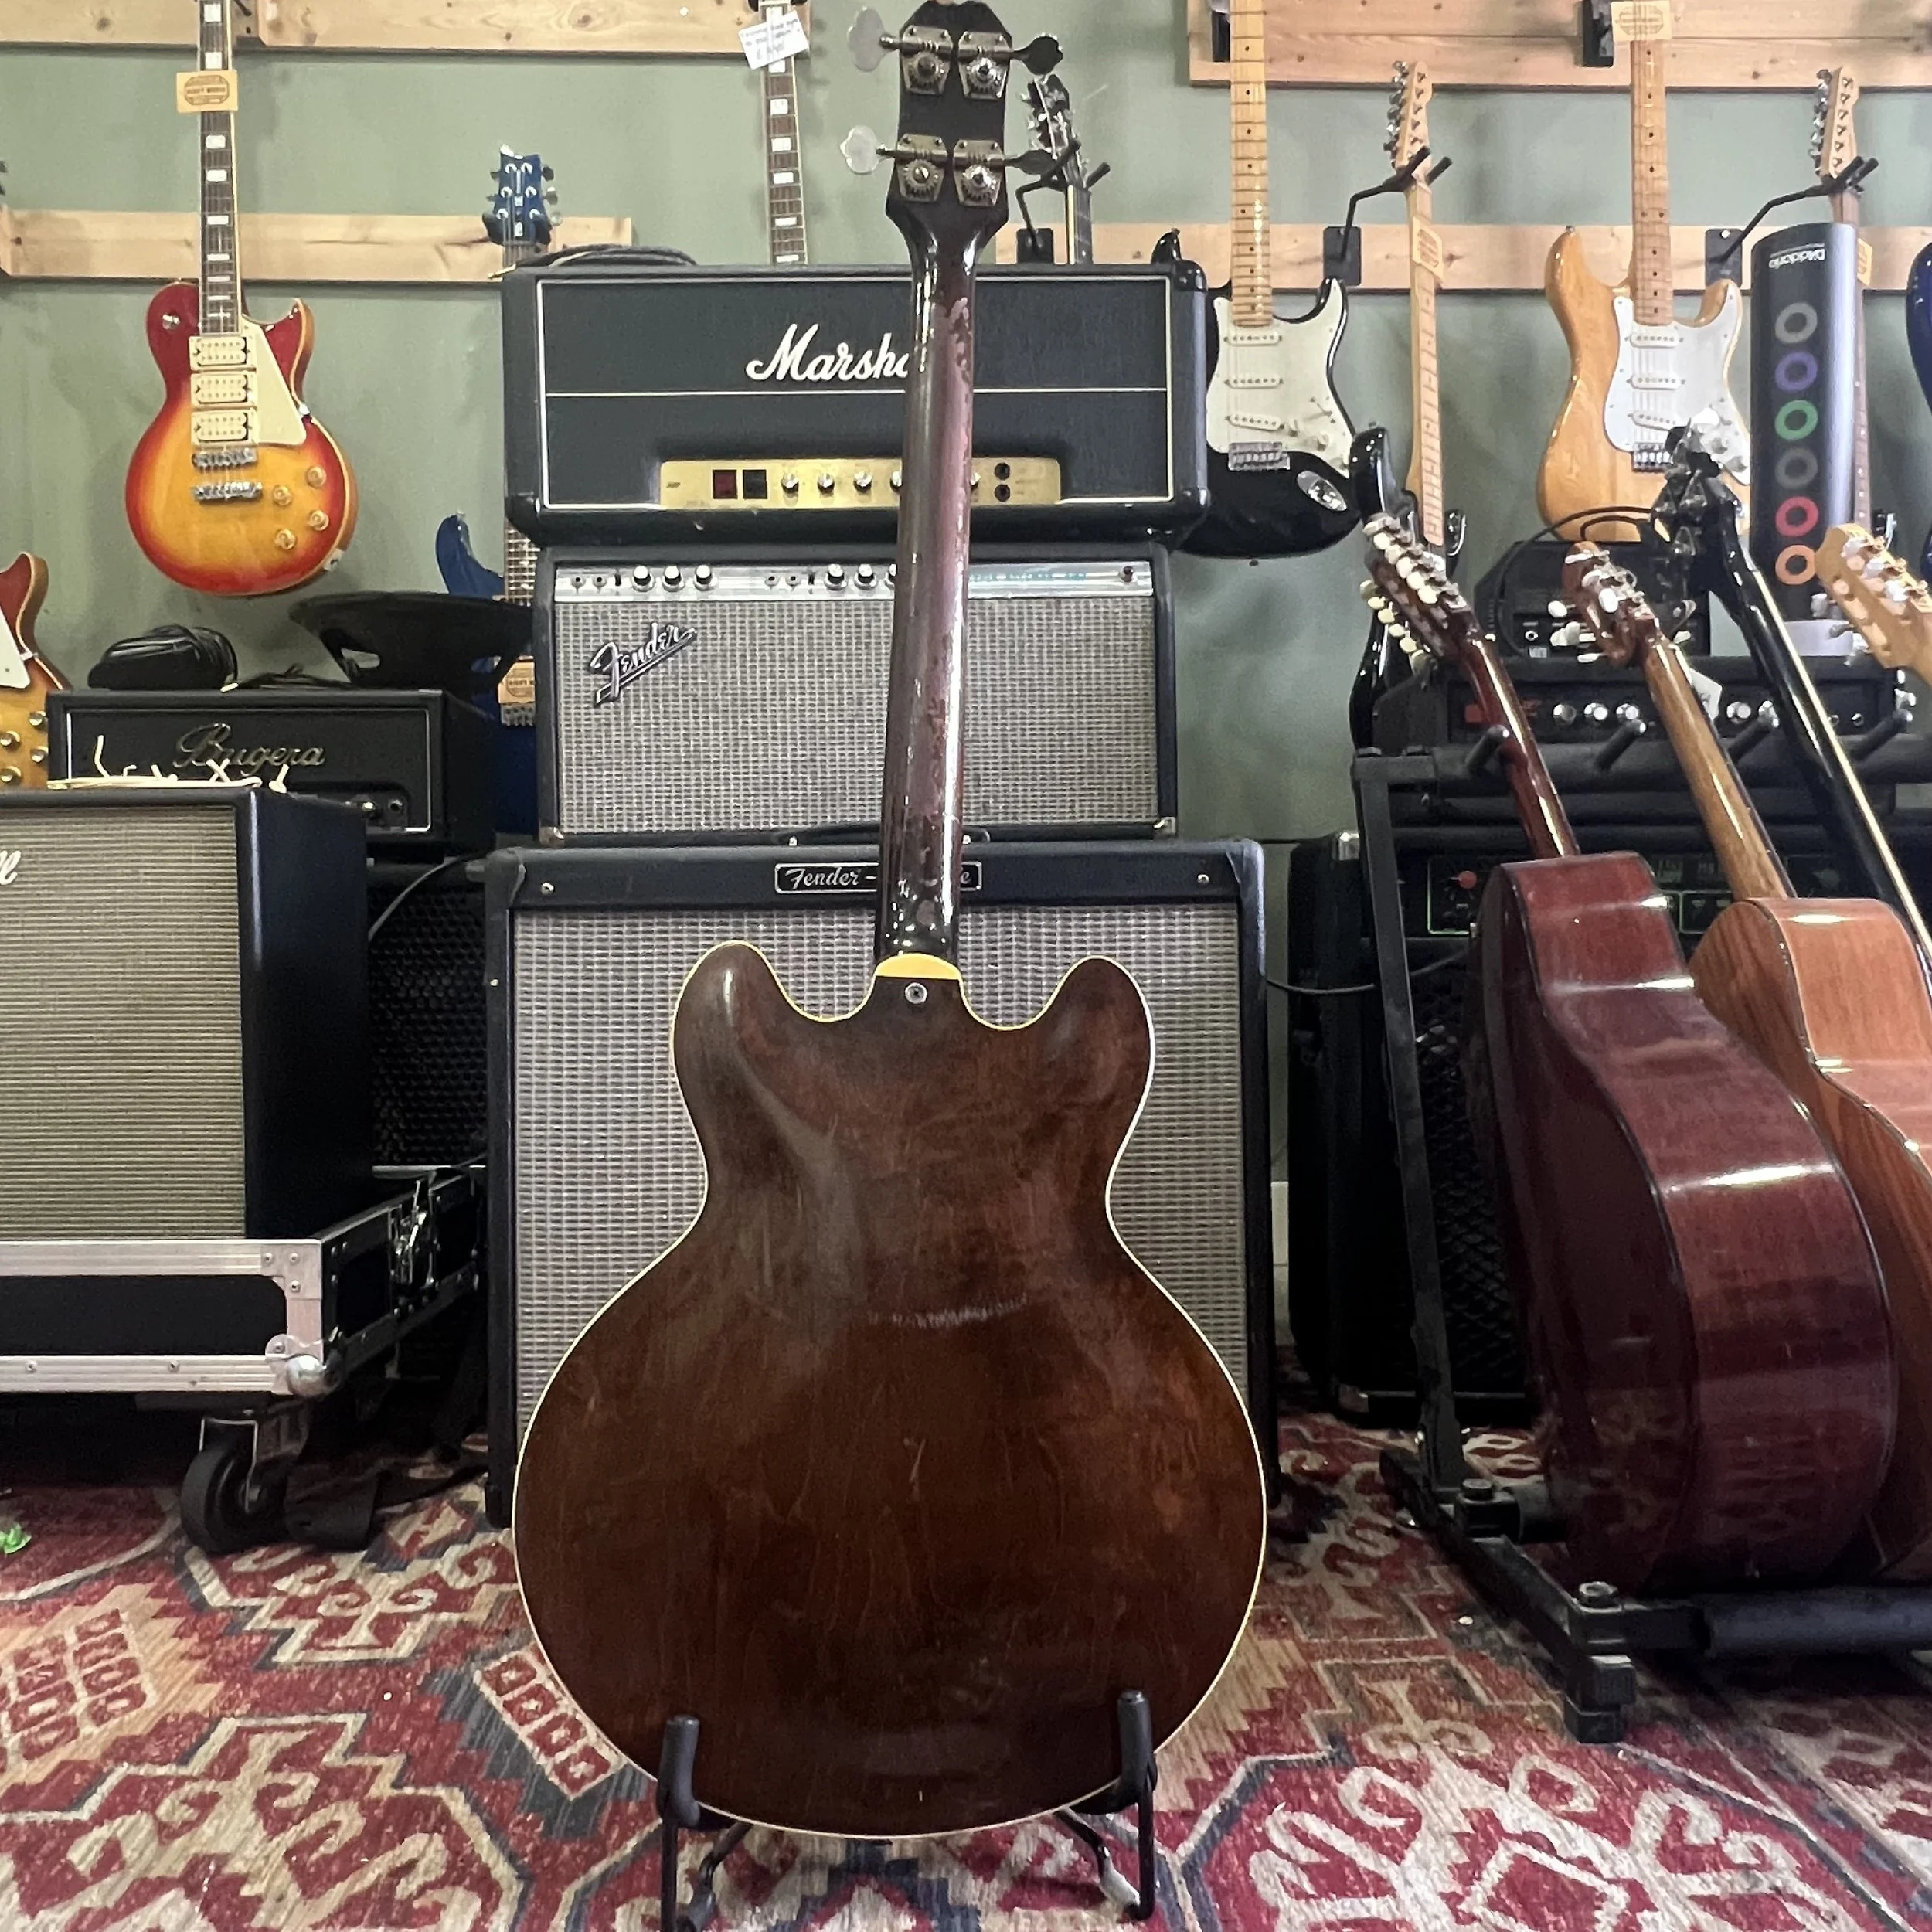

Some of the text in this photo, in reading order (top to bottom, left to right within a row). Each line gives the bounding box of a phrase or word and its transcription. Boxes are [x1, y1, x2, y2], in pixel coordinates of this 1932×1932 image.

[590, 622, 696, 704] Fender
[172, 722, 325, 777] Bugera
[784, 866, 860, 890] Fender
